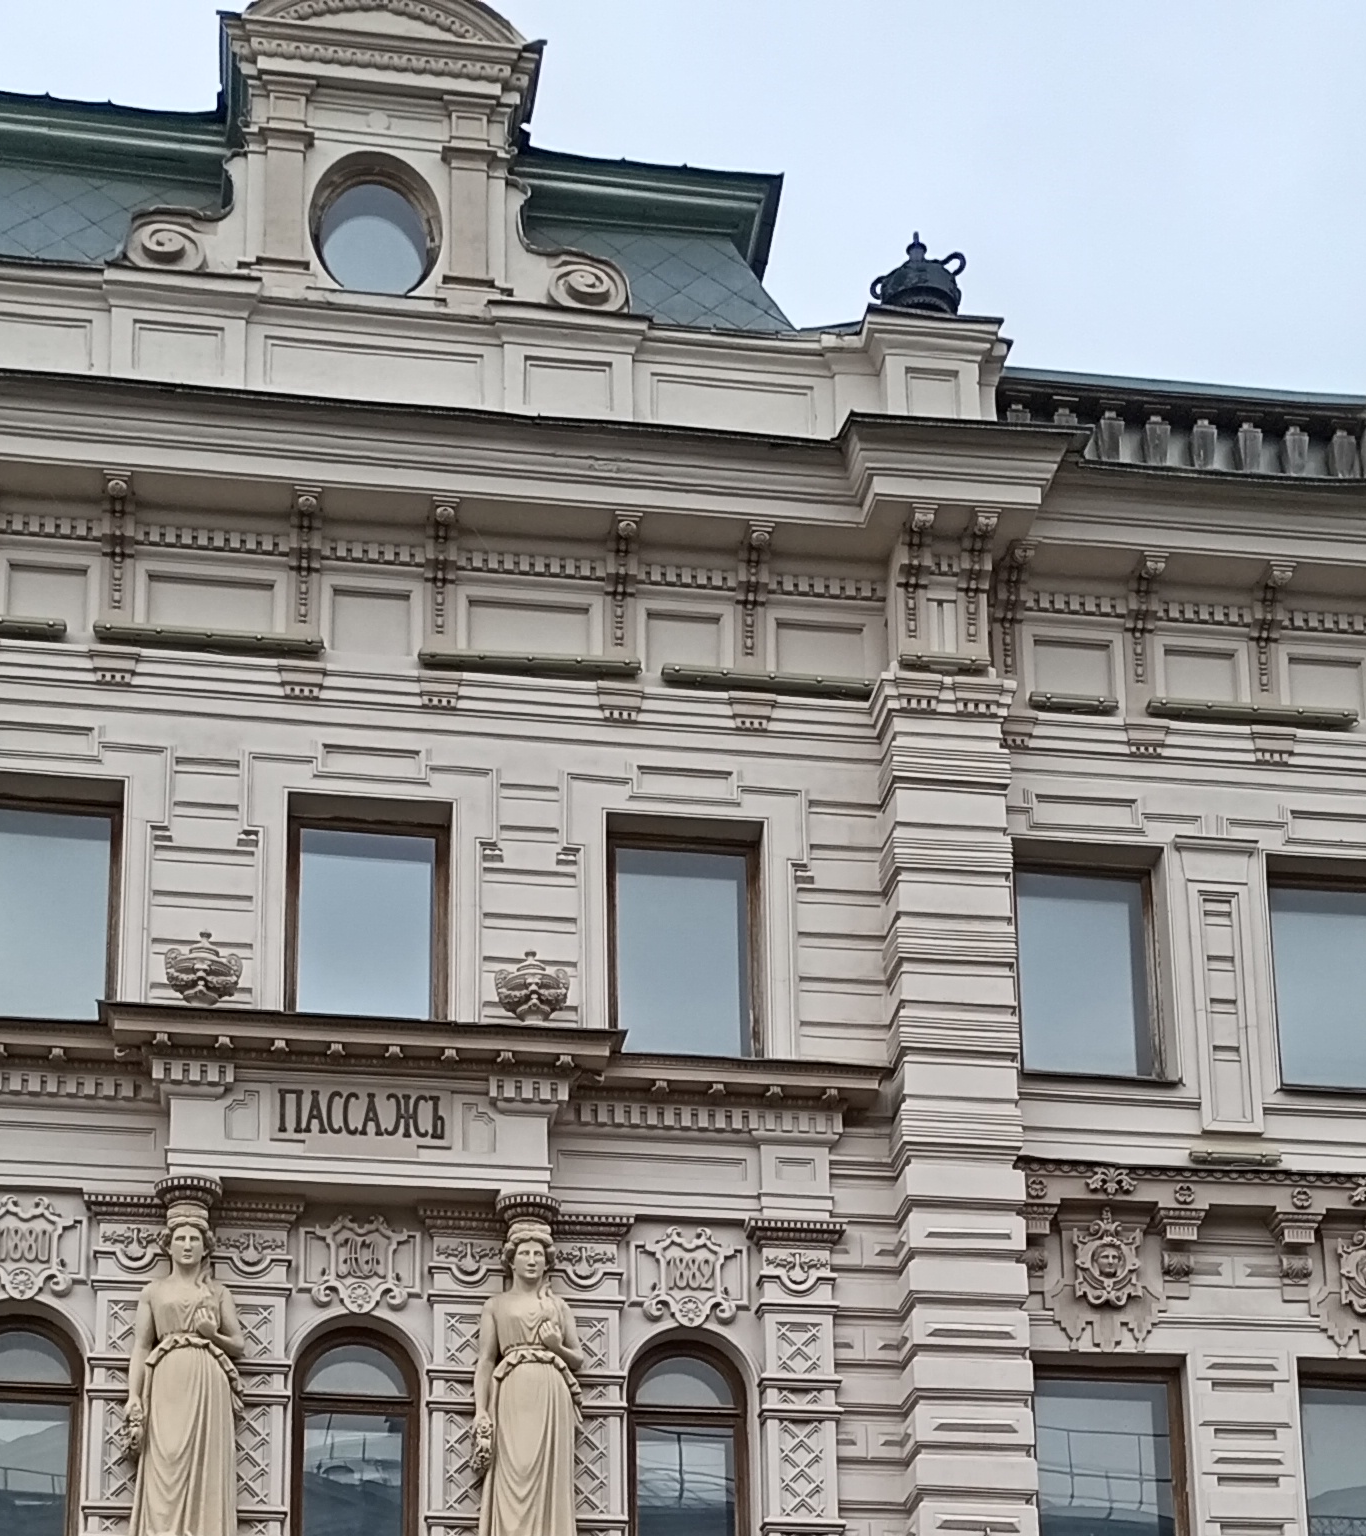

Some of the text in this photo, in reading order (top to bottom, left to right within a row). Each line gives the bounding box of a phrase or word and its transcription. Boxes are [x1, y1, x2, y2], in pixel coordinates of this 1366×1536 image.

[277, 1088, 446, 1140] ПАССАЖЪ
[0, 1226, 51, 1263] 1880
[667, 1256, 715, 1291] 1882
